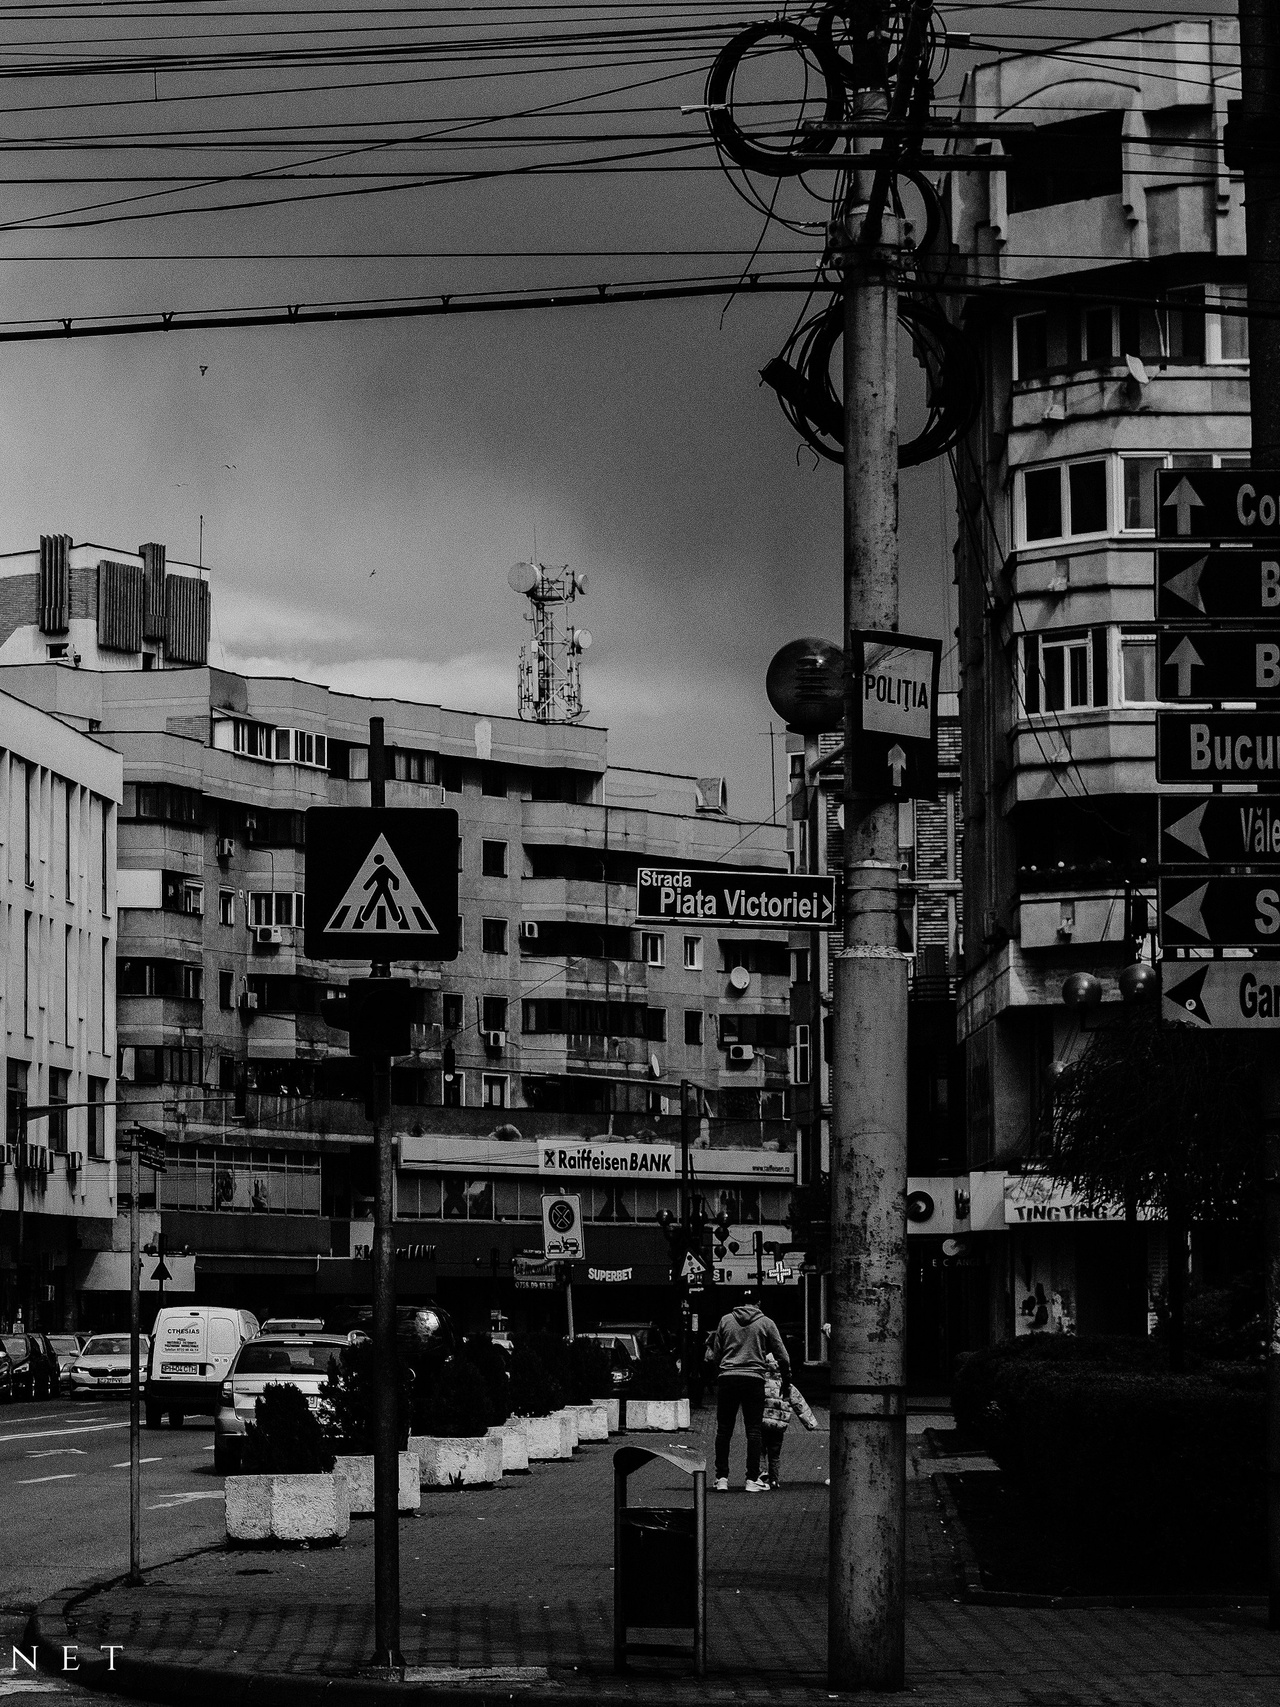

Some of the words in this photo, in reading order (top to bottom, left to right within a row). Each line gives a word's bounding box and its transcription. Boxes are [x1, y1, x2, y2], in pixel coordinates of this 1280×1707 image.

[1236, 483, 1280, 526] Co
[1189, 723, 1280, 770] Bucu
[640, 869, 692, 888] Strada
[723, 889, 818, 919] Victoriei
[587, 1267, 633, 1282] SUPERBET
